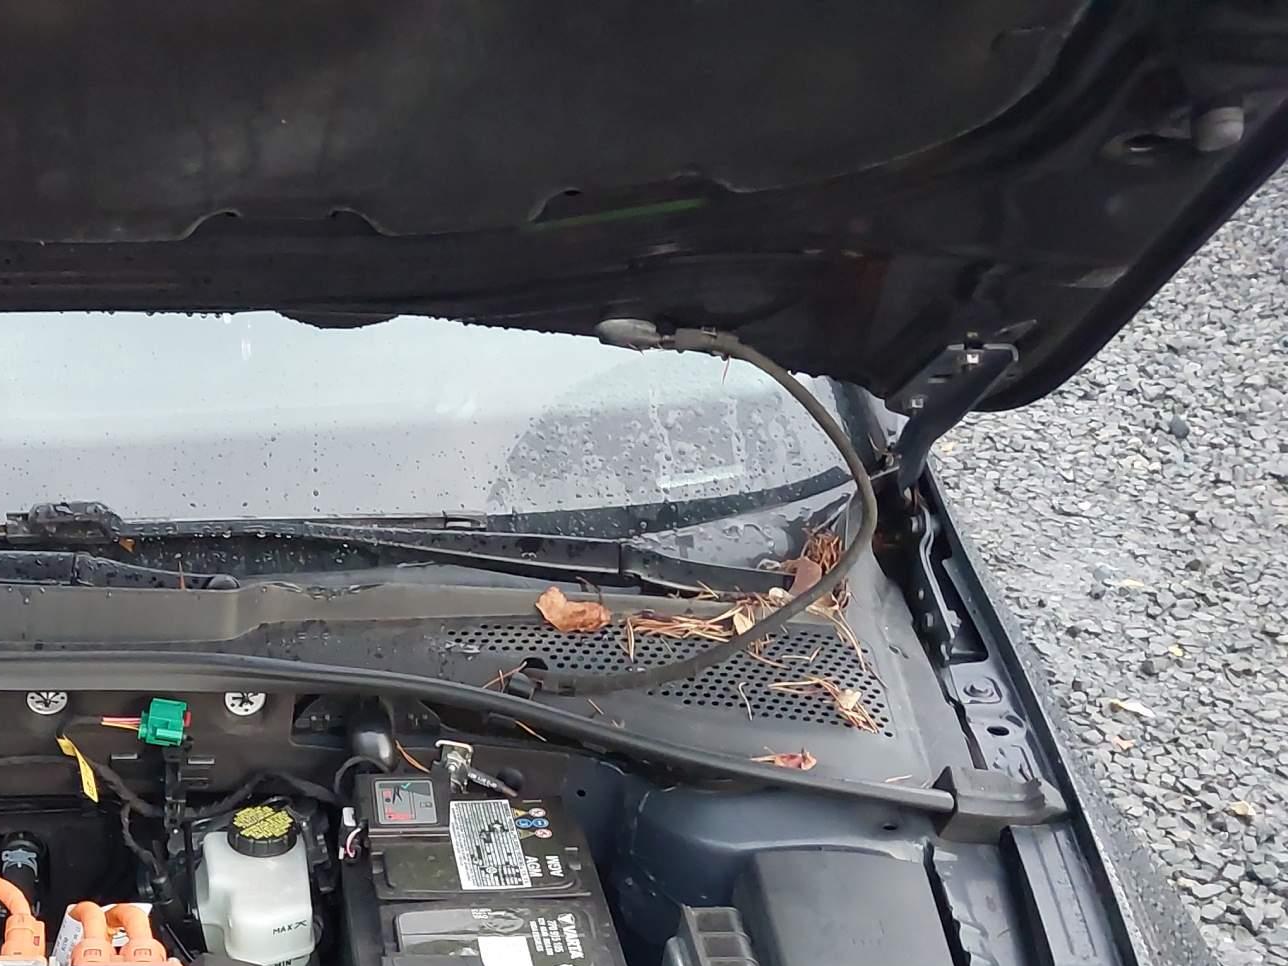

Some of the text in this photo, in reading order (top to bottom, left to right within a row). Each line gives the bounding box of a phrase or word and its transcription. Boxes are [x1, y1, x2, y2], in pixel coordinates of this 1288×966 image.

[525, 855, 543, 878] AGM
[545, 855, 565, 878] AGM
[272, 923, 293, 935] MAX
[562, 926, 585, 959] VARTA
